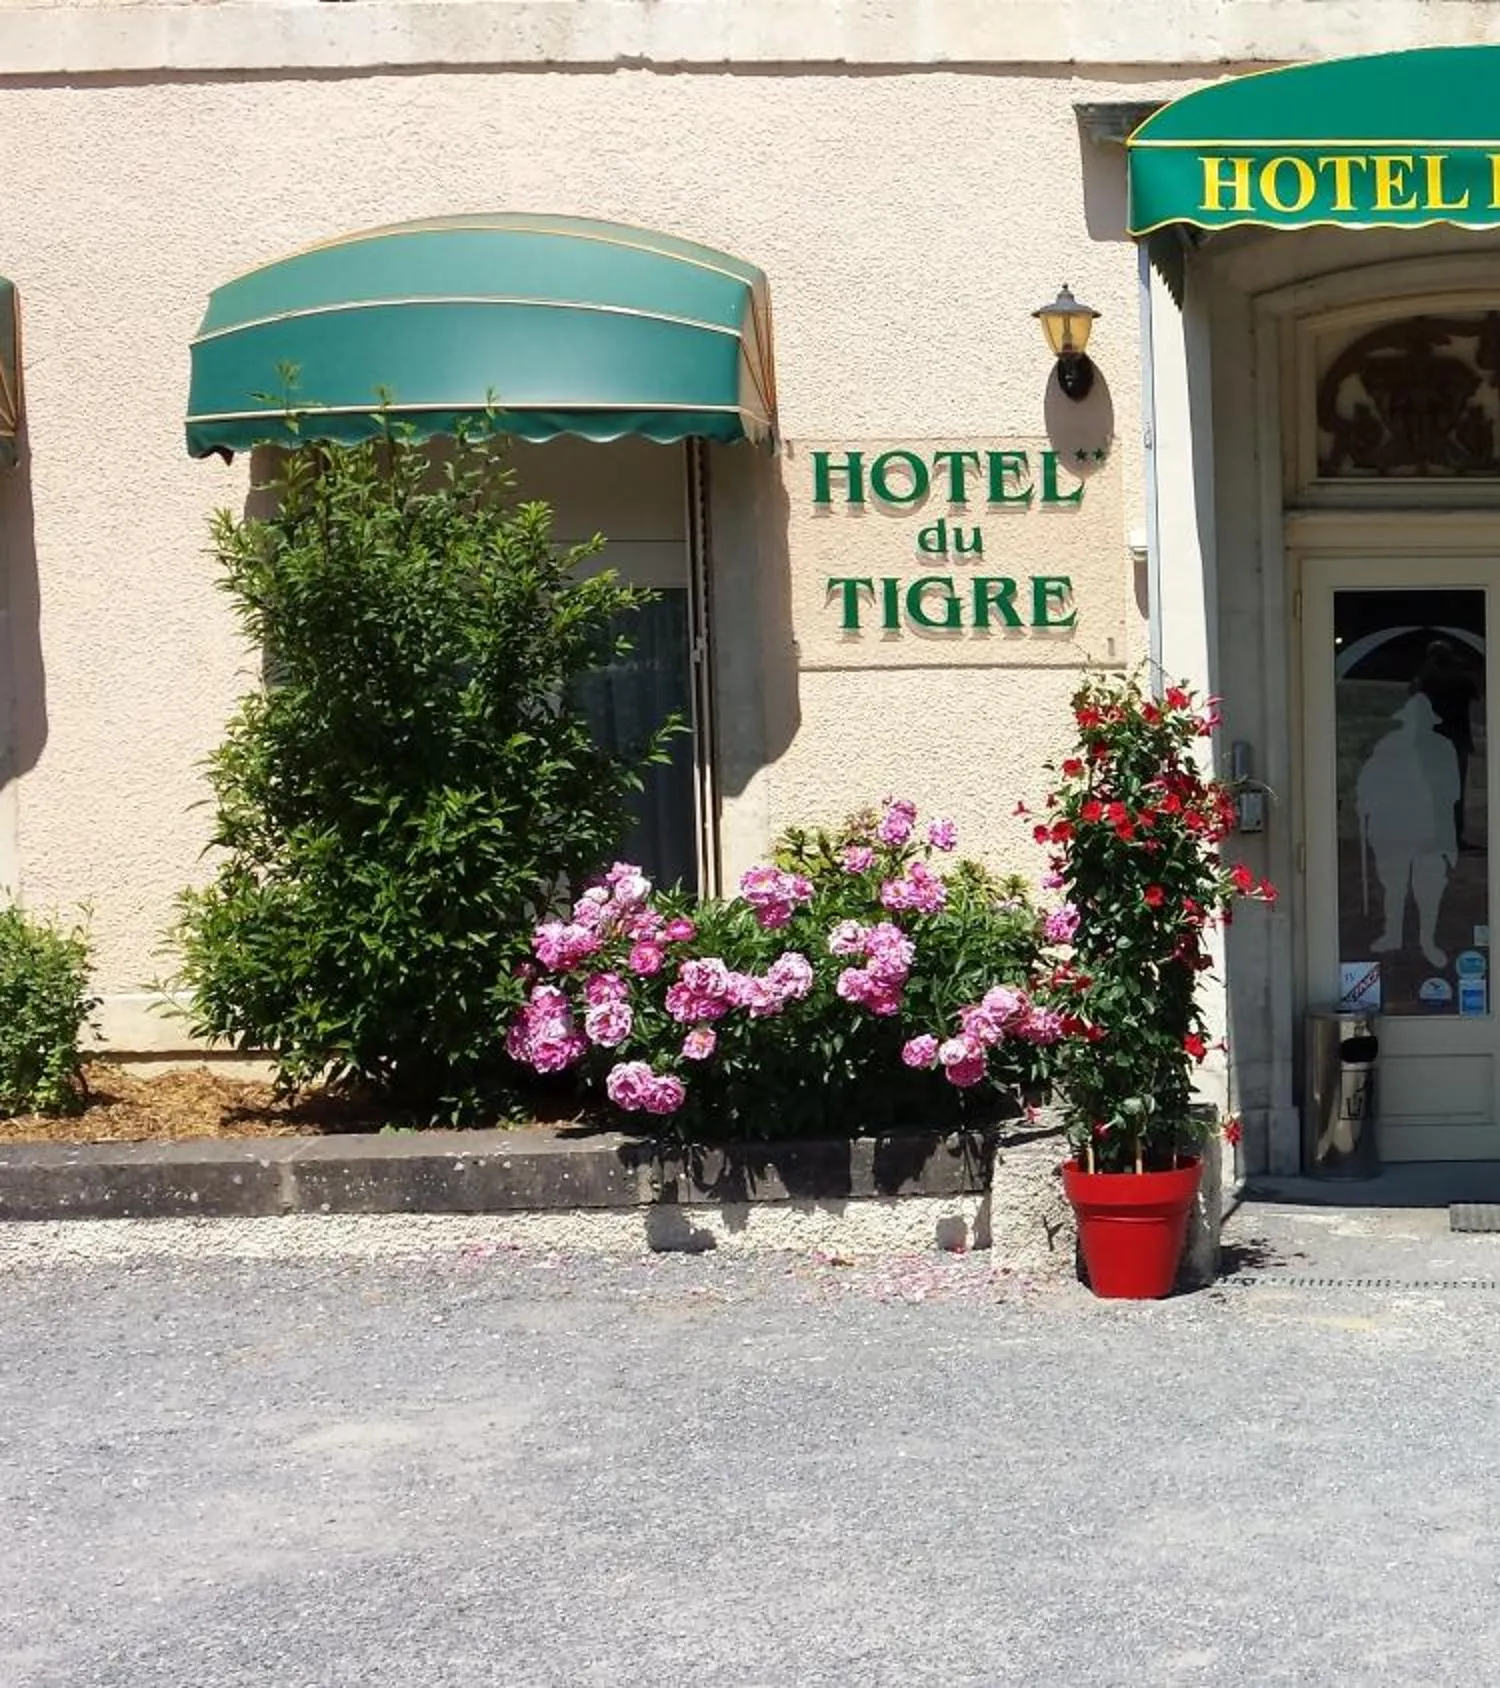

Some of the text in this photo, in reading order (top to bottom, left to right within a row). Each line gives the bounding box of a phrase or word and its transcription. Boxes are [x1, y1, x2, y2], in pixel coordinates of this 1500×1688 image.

[1198, 154, 1469, 212] HOTEL
[810, 450, 1085, 504] HOTEL
[917, 518, 984, 553] du
[825, 575, 1078, 629] TIGRE
